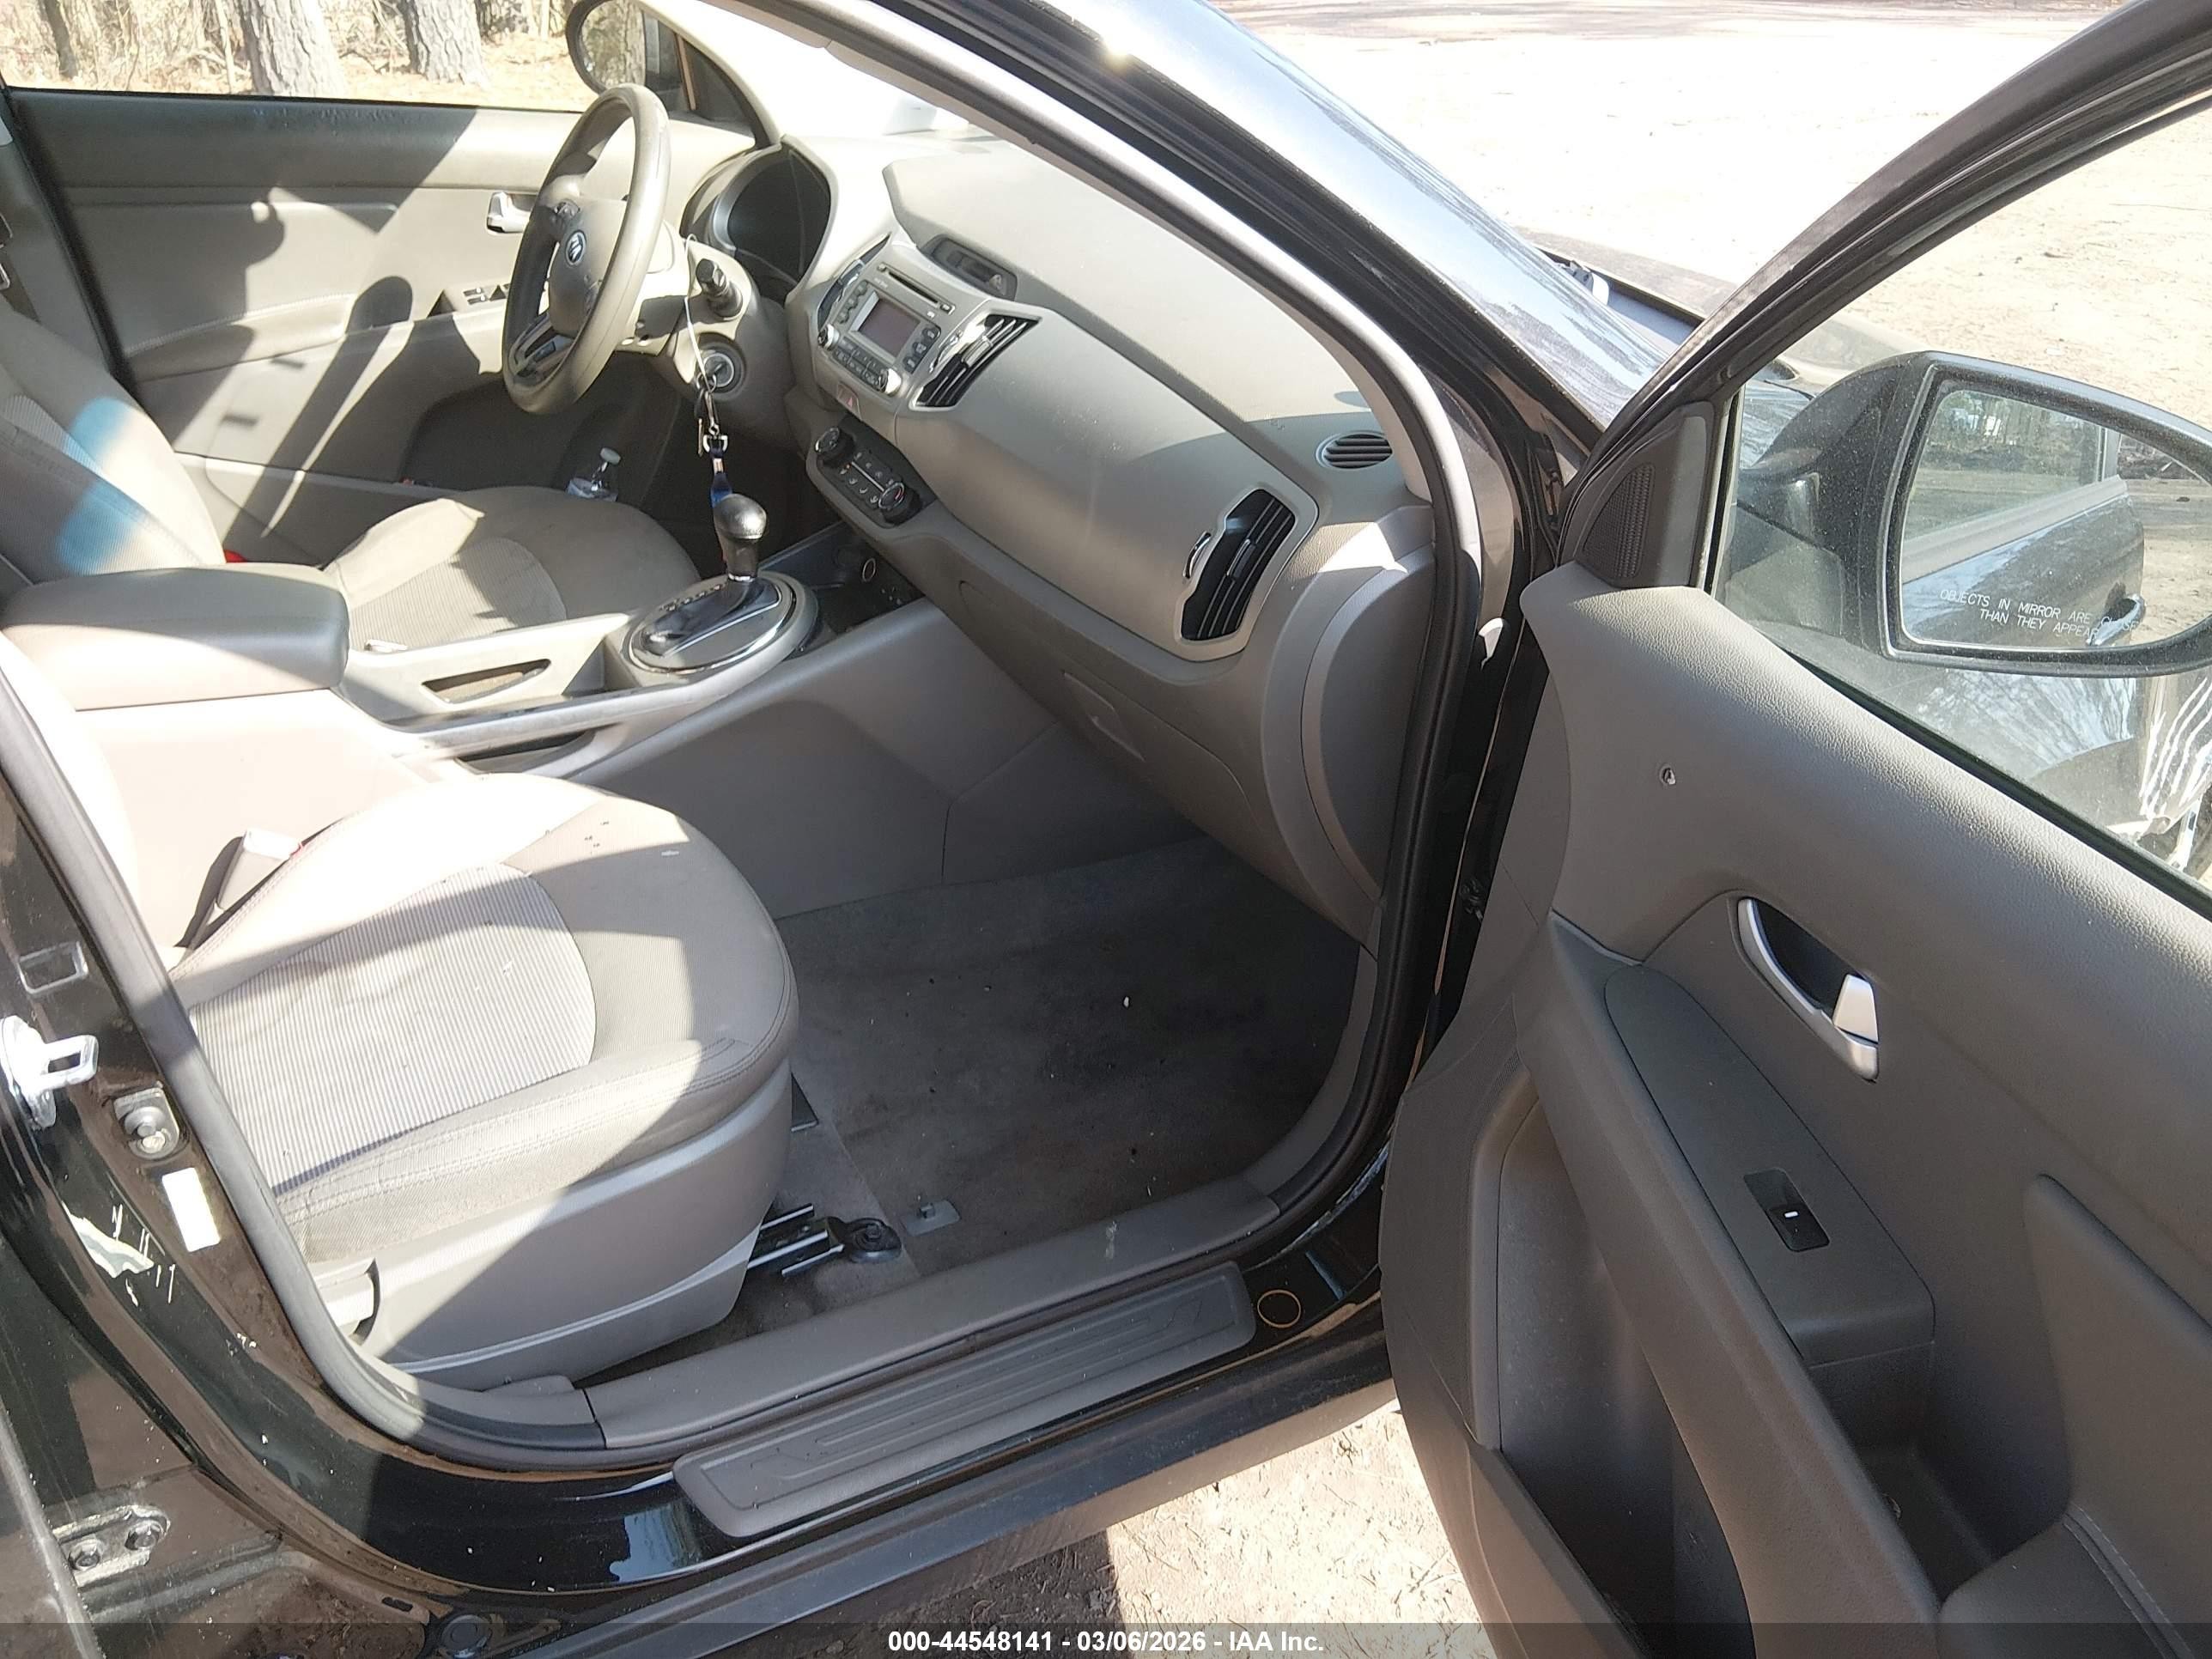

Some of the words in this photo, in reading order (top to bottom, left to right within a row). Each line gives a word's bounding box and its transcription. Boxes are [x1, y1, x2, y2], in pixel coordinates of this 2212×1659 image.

[1940, 589, 1990, 607] OBJECTS
[1998, 598, 2010, 611] IN
[2018, 602, 2061, 619] MIRROR
[2069, 611, 2093, 624] ARE
[1979, 608, 2008, 623] THAN
[2017, 615, 2045, 629] THEY
[2052, 622, 2099, 640] APPEAR
